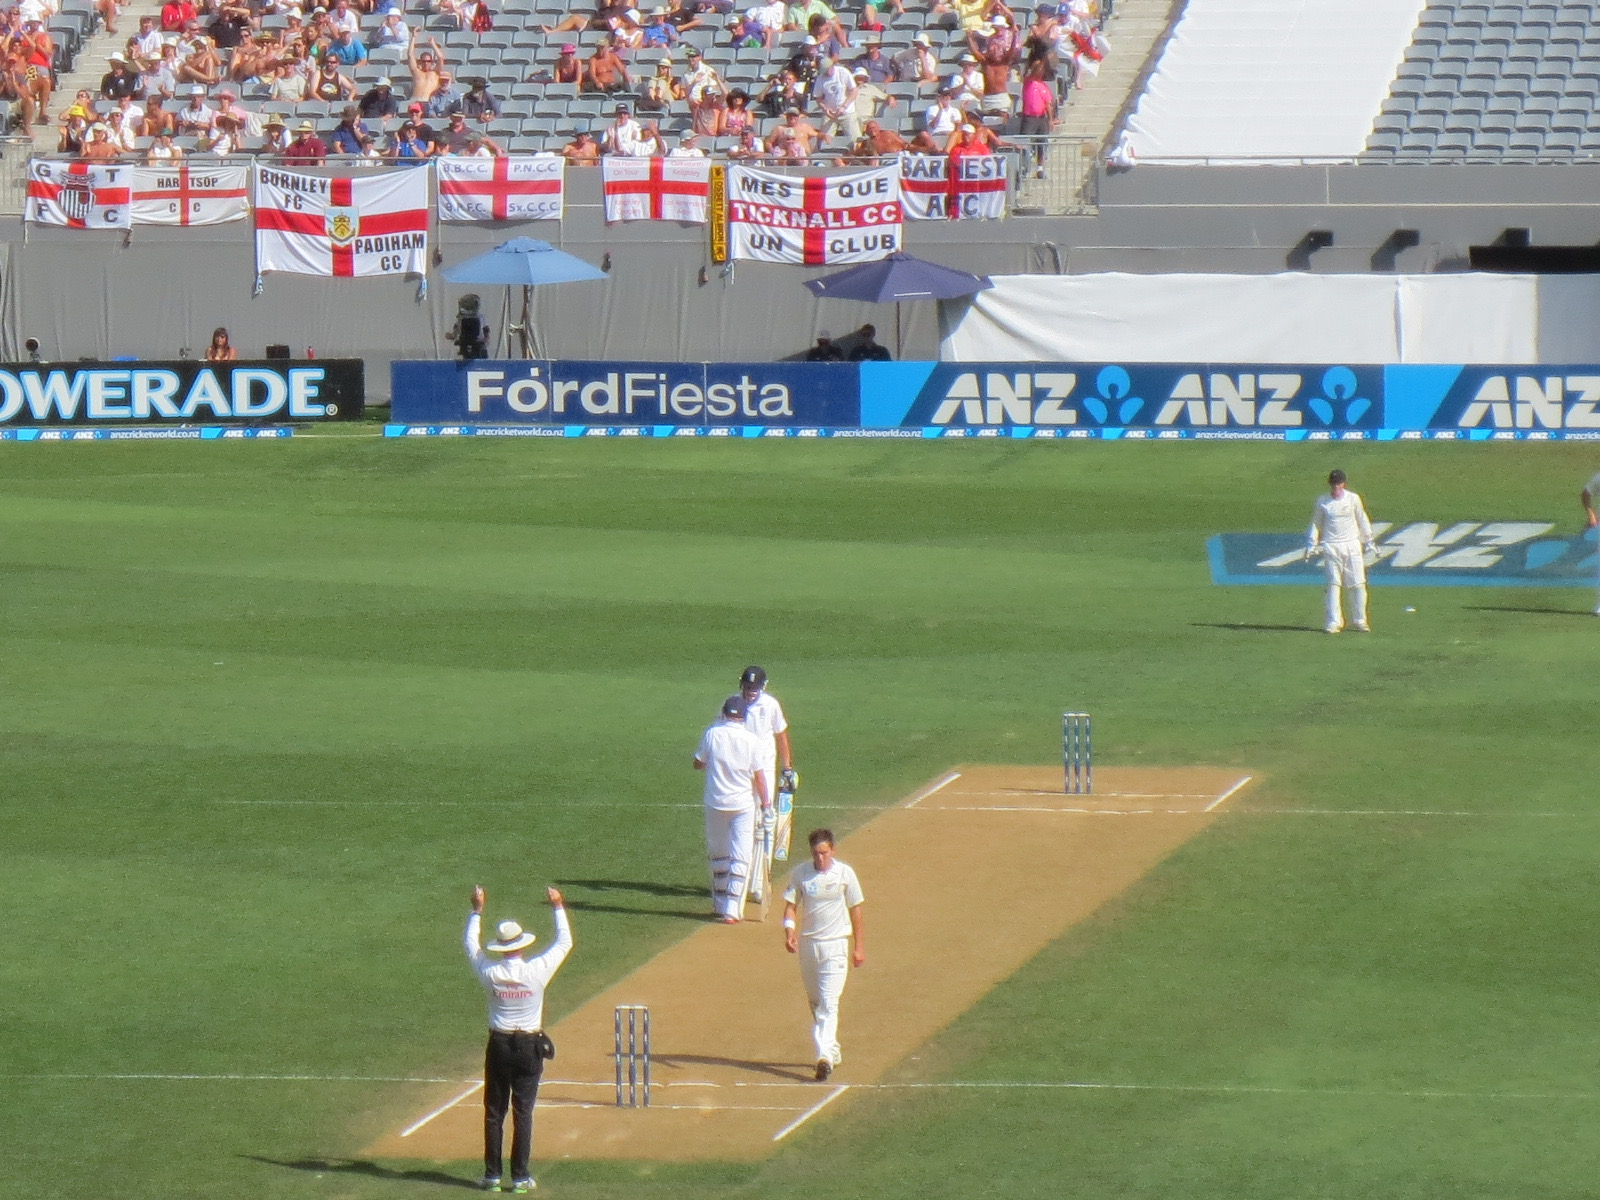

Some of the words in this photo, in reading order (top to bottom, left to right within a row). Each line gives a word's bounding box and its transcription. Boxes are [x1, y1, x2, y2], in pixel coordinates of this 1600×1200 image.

[35, 163, 50, 177] G
[105, 168, 120, 183] T
[157, 177, 180, 188] HAR
[189, 177, 218, 188] TSOP
[260, 169, 327, 194] BURNLEY
[741, 177, 792, 198] MES
[838, 177, 889, 198] QUE
[169, 202, 177, 213] C
[193, 202, 201, 213] C
[284, 194, 303, 210] FC
[103, 209, 118, 223] C
[733, 203, 857, 228] TICKNALL
[863, 204, 897, 223] CC
[355, 234, 424, 254] PADIHAM
[750, 234, 783, 251] UN
[830, 234, 896, 254] CLUB
[381, 255, 402, 271] CC
[930, 373, 1077, 425] ANZ
[1154, 373, 1303, 426] ANZ
[1458, 376, 1600, 428] ANZ
[40, 431, 60, 439] ANZ
[73, 431, 94, 439] ANZ
[110, 430, 199, 439] anzcricketworld.co.nz
[475, 428, 564, 436] anzcricketworld.co.nz
[586, 428, 607, 436] ANZ
[618, 428, 639, 436] ANZ
[675, 428, 696, 436] ANZ
[708, 428, 729, 436] ANZ
[797, 429, 818, 437] ANZ
[832, 429, 922, 438] anzcricketworld.co.nz
[944, 429, 965, 437] ANZ
[977, 429, 998, 437] ANZ
[1125, 430, 1146, 438] ANZ
[1158, 430, 1179, 438] ANZ
[1195, 431, 1285, 440] anzcricketworld.co.nz
[1400, 431, 1421, 439] ANZ
[1433, 431, 1455, 439] ANZ
[493, 989, 533, 999] Emirates
